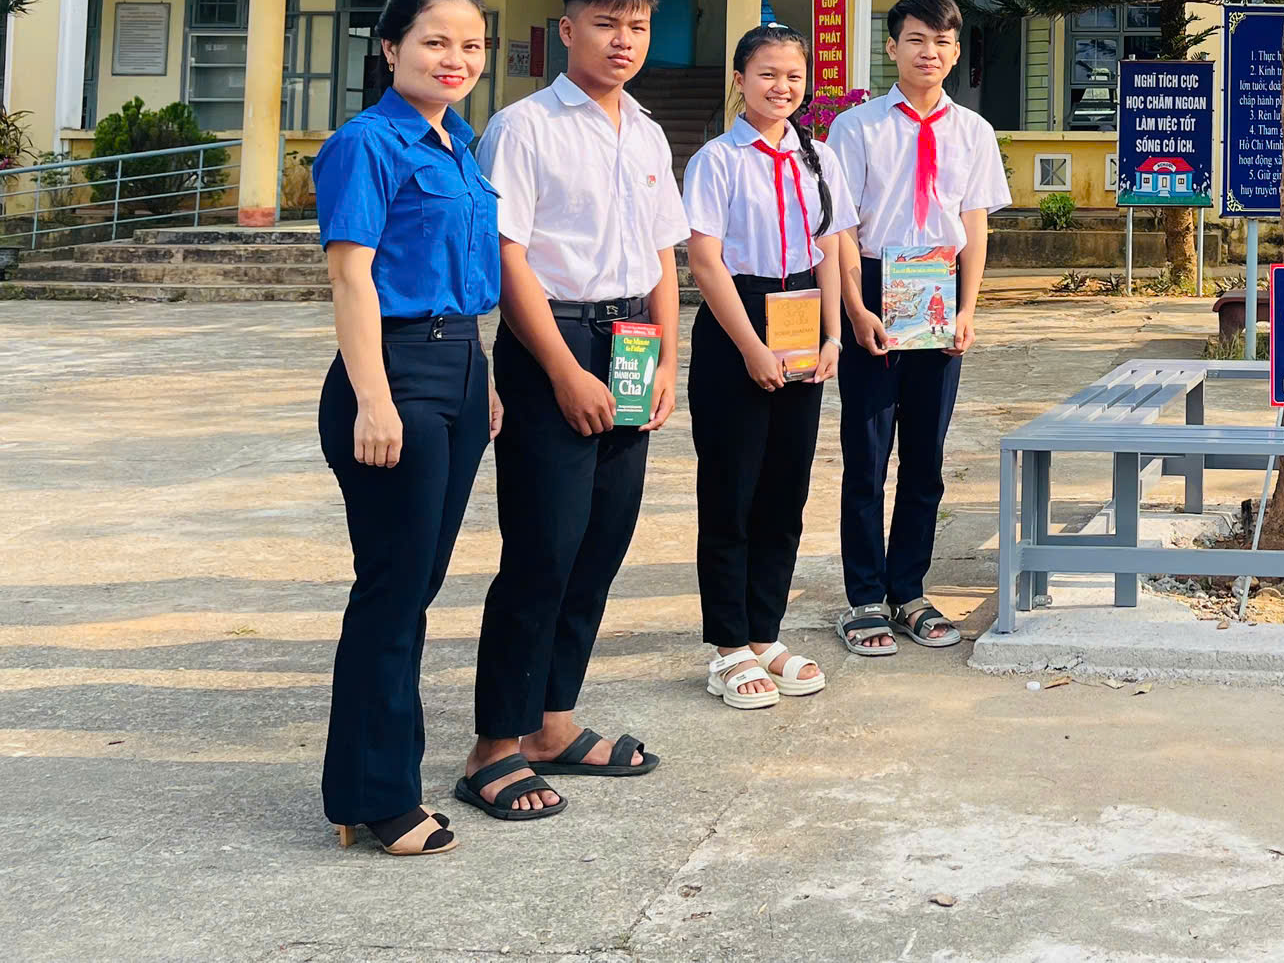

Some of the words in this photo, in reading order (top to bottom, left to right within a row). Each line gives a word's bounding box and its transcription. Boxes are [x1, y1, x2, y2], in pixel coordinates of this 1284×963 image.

[1134, 72, 1156, 88] NGHĨ
[1158, 72, 1178, 88] TÍCH
[1180, 74, 1199, 91] CỰC
[1126, 96, 1144, 112] HỌC
[1146, 94, 1173, 110] CHĂM
[1175, 96, 1207, 110] NGOAN
[1135, 114, 1155, 131] LÀM
[1157, 115, 1178, 134] VIỆC
[1180, 114, 1196, 131] TỐT
[1258, 125, 1278, 135] Tham
[1135, 135, 1160, 153] SỐNG
[1162, 137, 1175, 153] CÓ
[1177, 137, 1195, 153] ÍCH.
[1265, 139, 1284, 150] Minh
[614, 356, 639, 370] Phút
[619, 380, 642, 396] Cha
